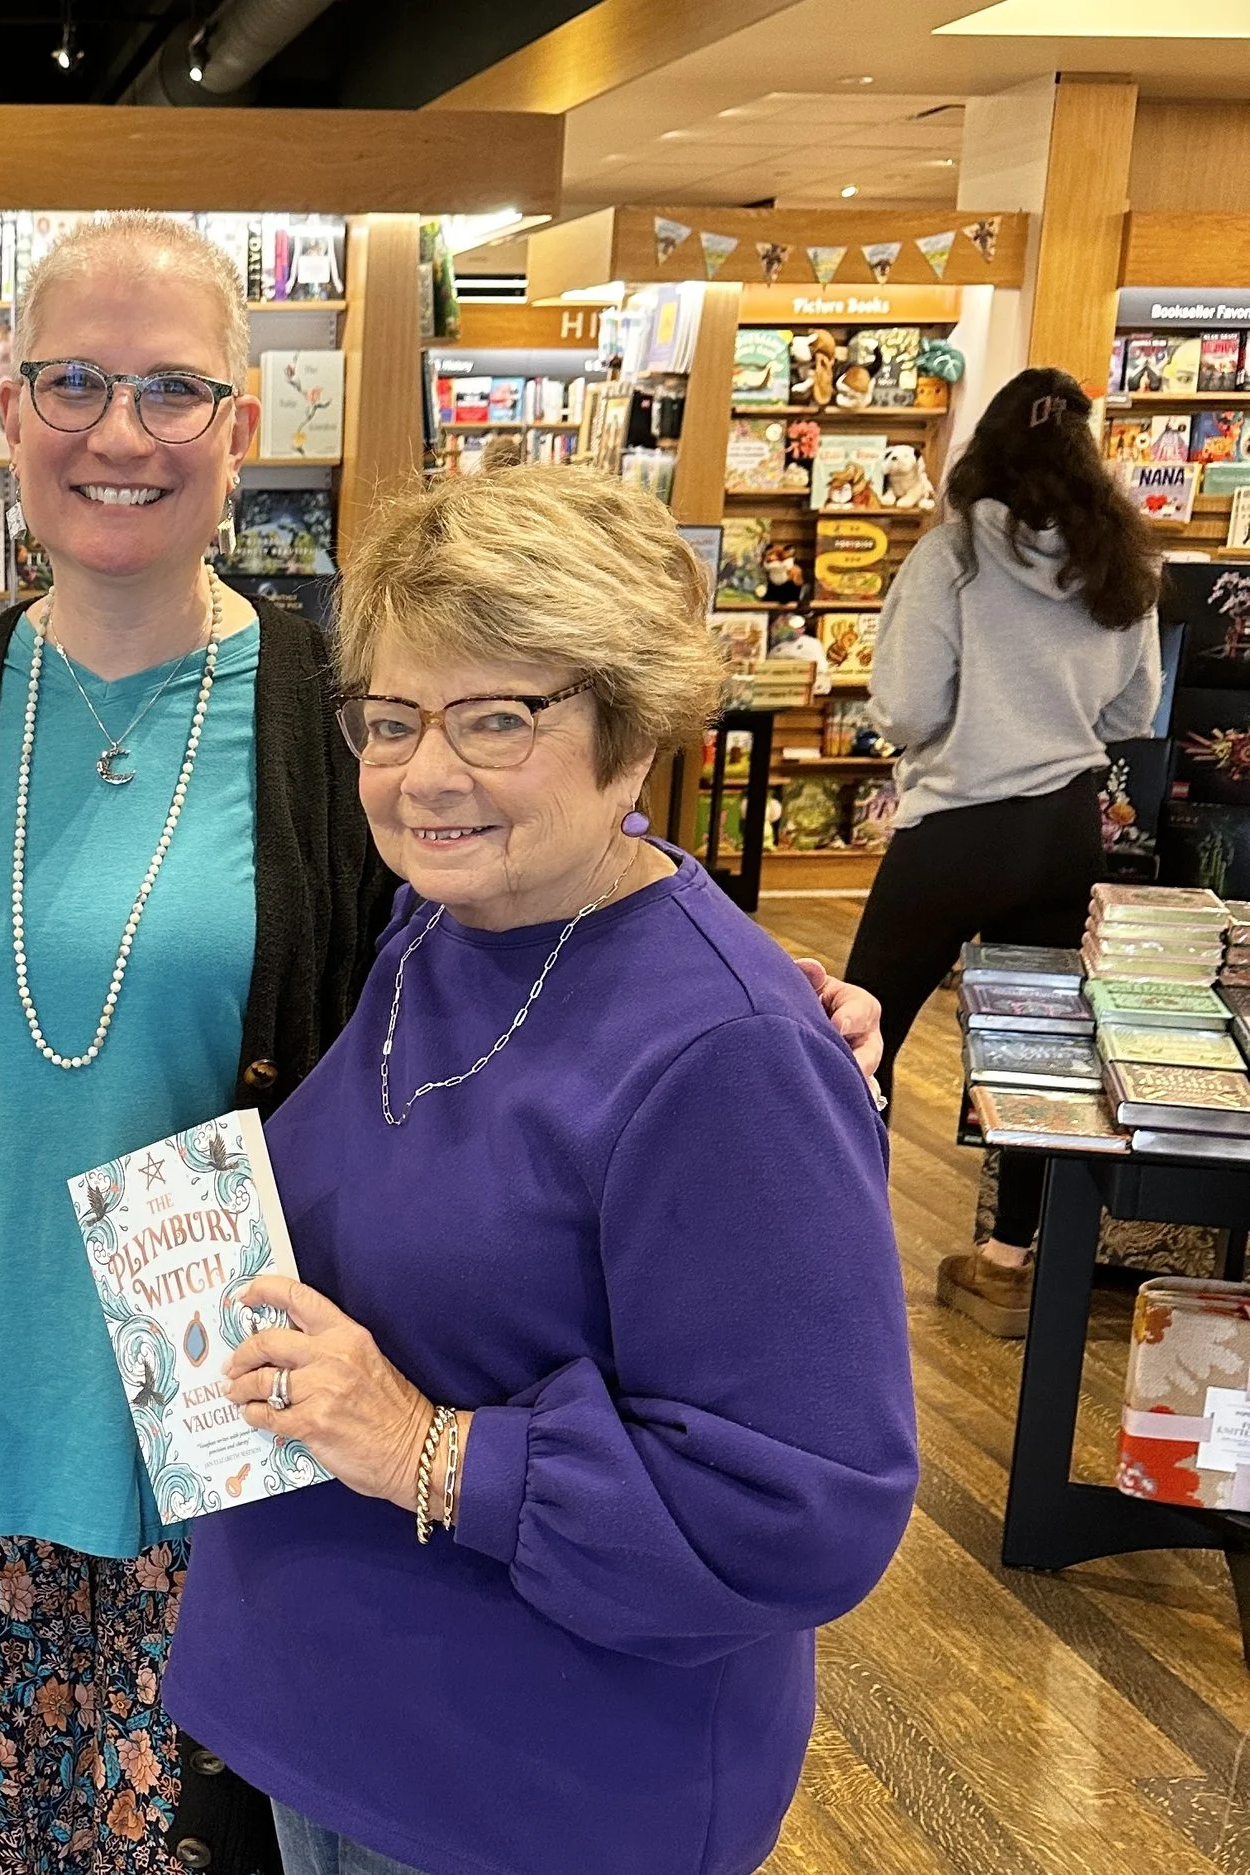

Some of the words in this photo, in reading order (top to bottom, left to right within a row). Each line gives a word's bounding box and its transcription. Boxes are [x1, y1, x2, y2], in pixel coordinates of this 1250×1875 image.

[793, 298, 844, 314] Picture
[847, 297, 890, 313] Books
[1151, 304, 1216, 319] Bookseller
[1216, 304, 1250, 319] Favor
[1139, 467, 1186, 487] NANA
[146, 1191, 174, 1217] THE
[108, 1208, 241, 1294] PLYMBURY
[132, 1252, 227, 1310] WITCH
